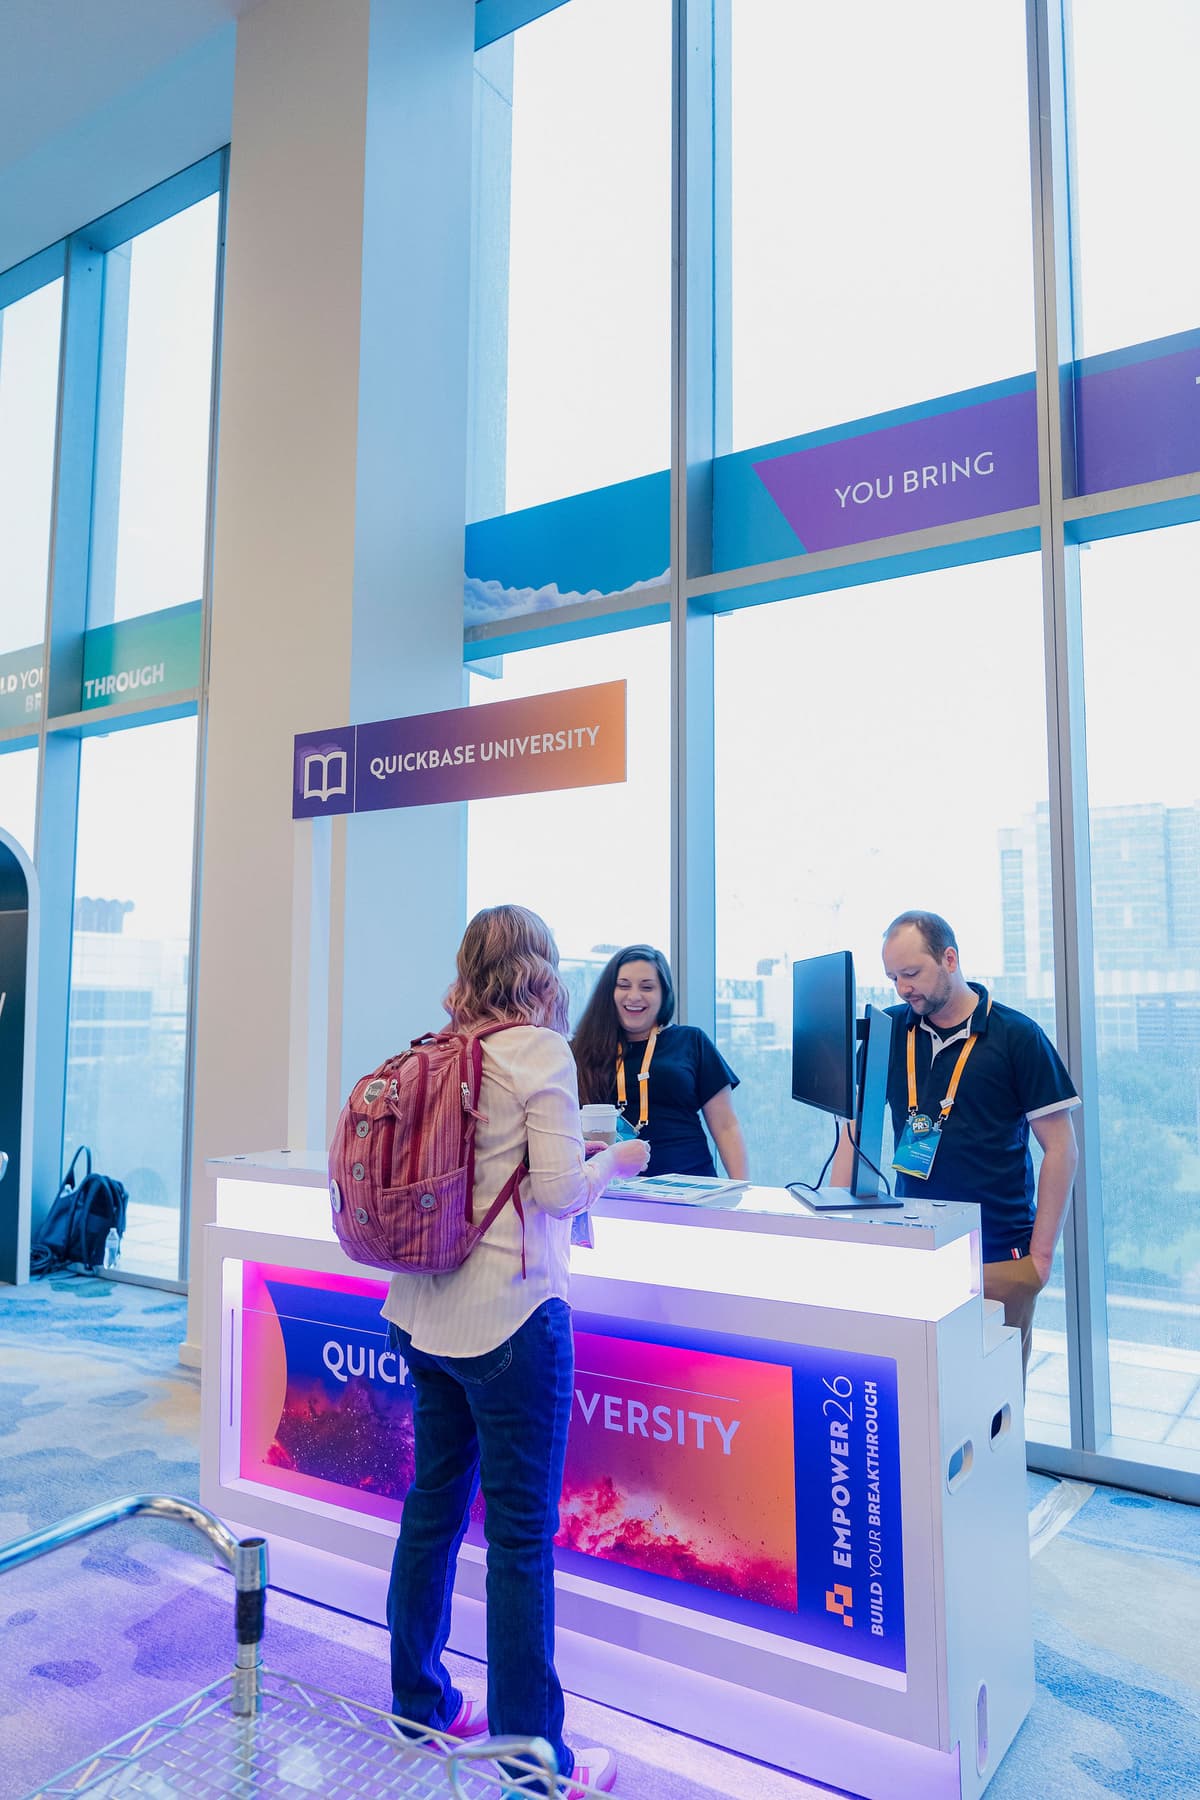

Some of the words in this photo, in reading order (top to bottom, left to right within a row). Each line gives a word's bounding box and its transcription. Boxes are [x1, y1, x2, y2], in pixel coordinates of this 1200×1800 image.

[834, 474, 894, 508] YOU
[904, 451, 995, 493] BRING
[84, 662, 165, 699] THROUGH
[369, 744, 475, 780] QUICKBASE
[480, 725, 600, 761] UNIVERSITY
[322, 1340, 410, 1387] QUICK
[569, 1388, 741, 1456] VERSITY
[864, 1381, 881, 1527] BREAKTHROUGH
[868, 1529, 882, 1578] YOUR
[870, 1582, 884, 1637] BUILD
